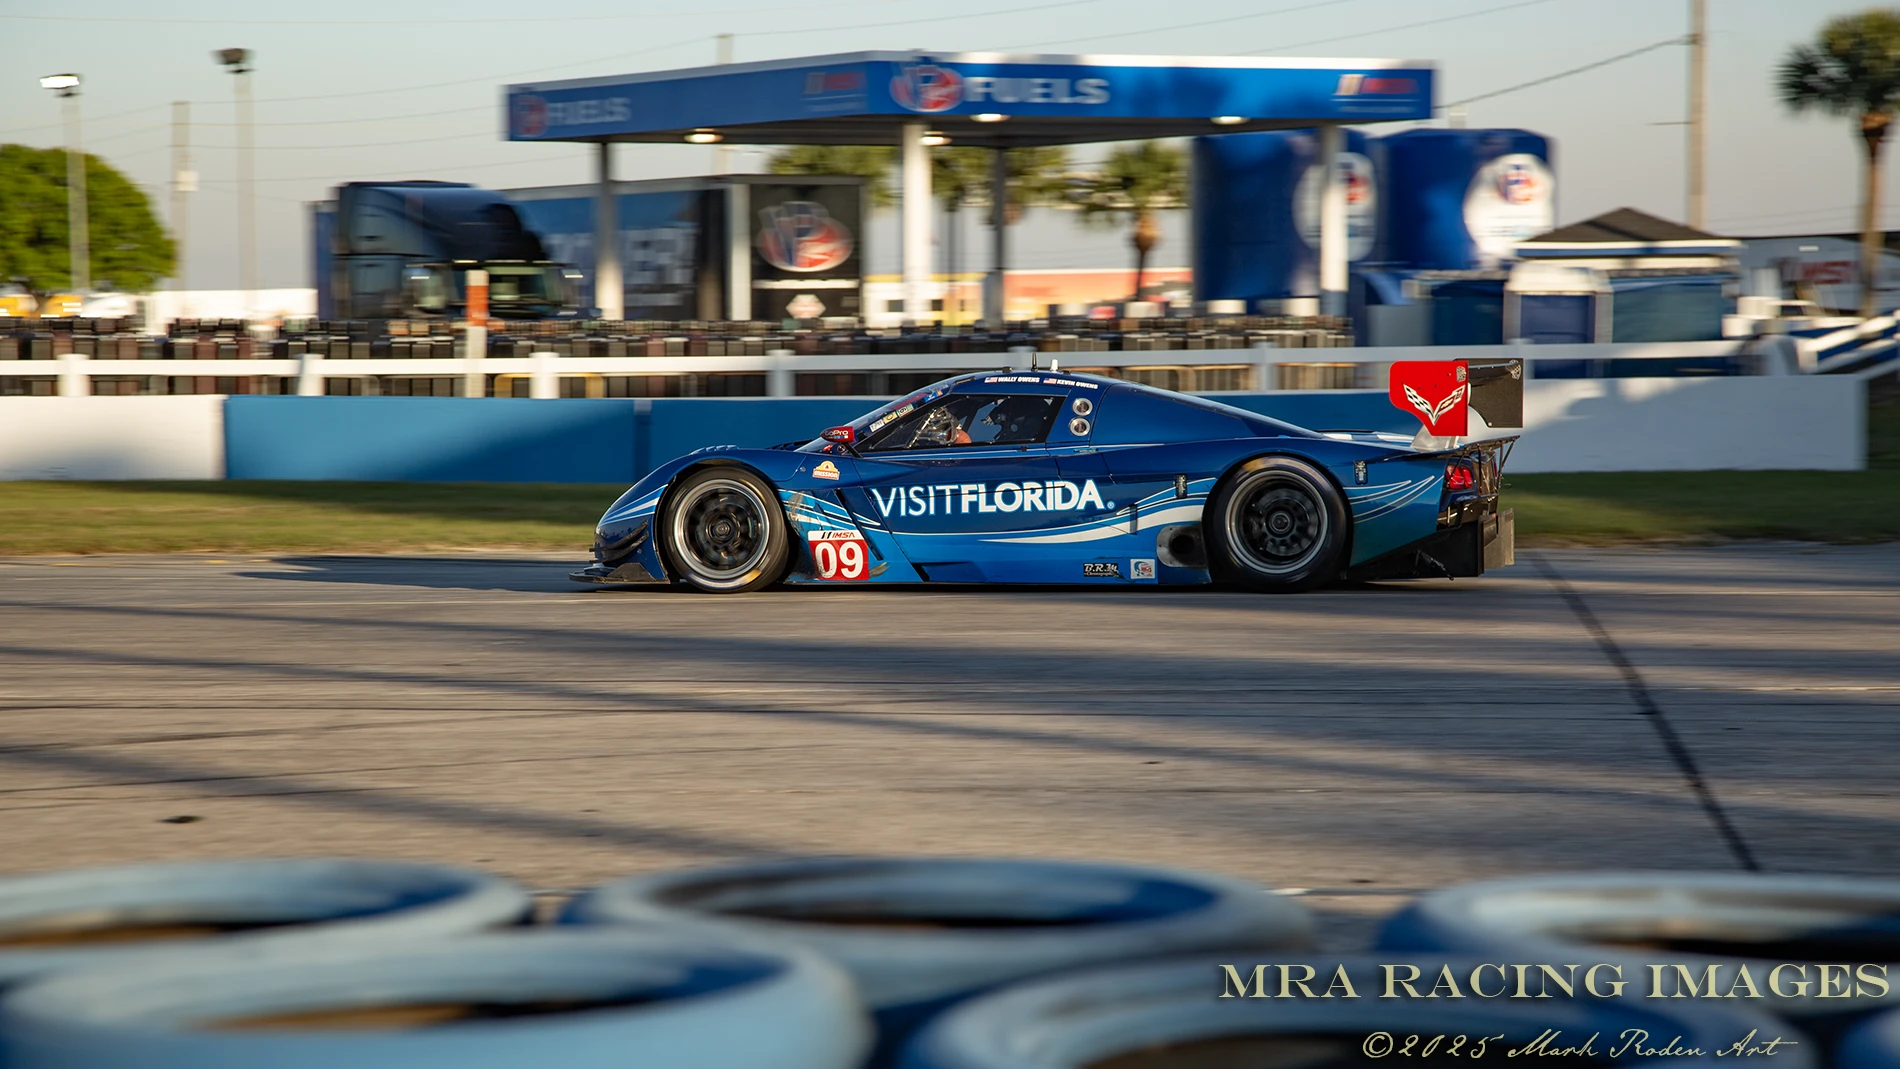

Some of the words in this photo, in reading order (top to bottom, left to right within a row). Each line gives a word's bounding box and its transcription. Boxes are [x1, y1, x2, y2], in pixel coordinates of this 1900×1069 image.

[963, 76, 1111, 104] FUELS
[1075, 381, 1098, 389] OWENS
[815, 541, 863, 578] 09
